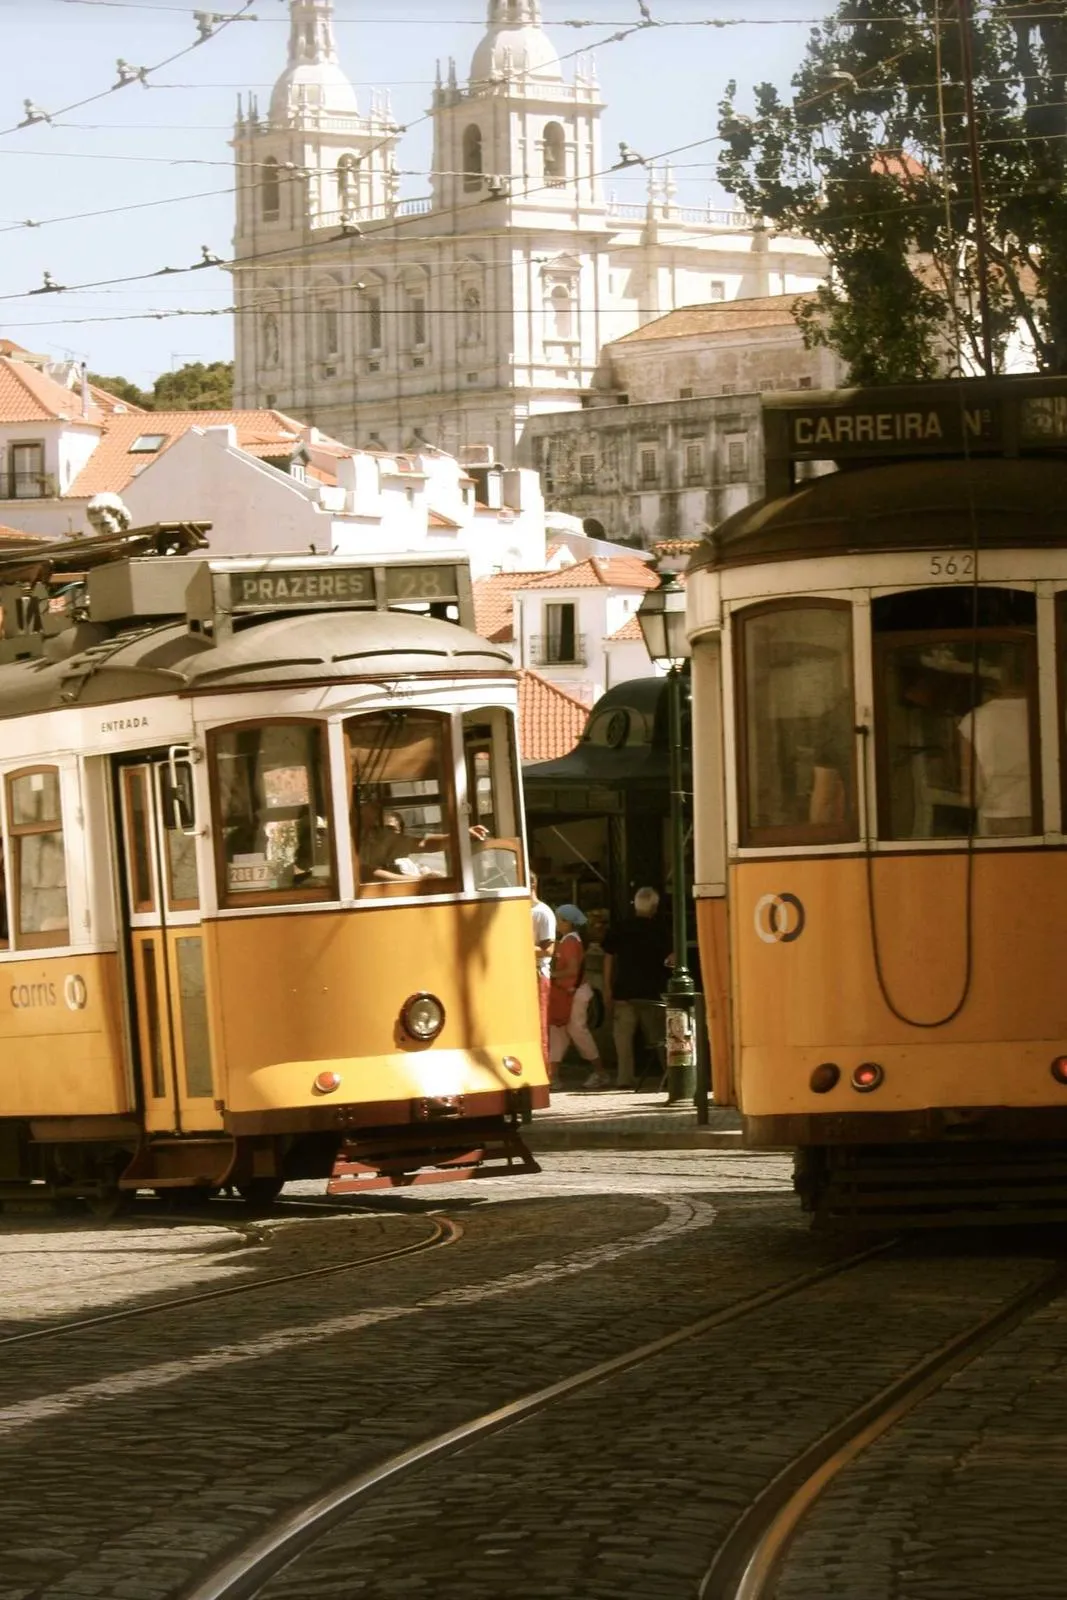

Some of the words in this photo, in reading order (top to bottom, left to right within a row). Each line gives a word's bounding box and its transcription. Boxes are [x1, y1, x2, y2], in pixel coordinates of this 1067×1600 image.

[794, 412, 943, 445] CARREIRA
[930, 555, 974, 576] 562
[243, 574, 365, 599] PRAZERES
[401, 571, 441, 598] 28
[101, 716, 149, 732] ENTRADA
[10, 971, 57, 1009] carris
